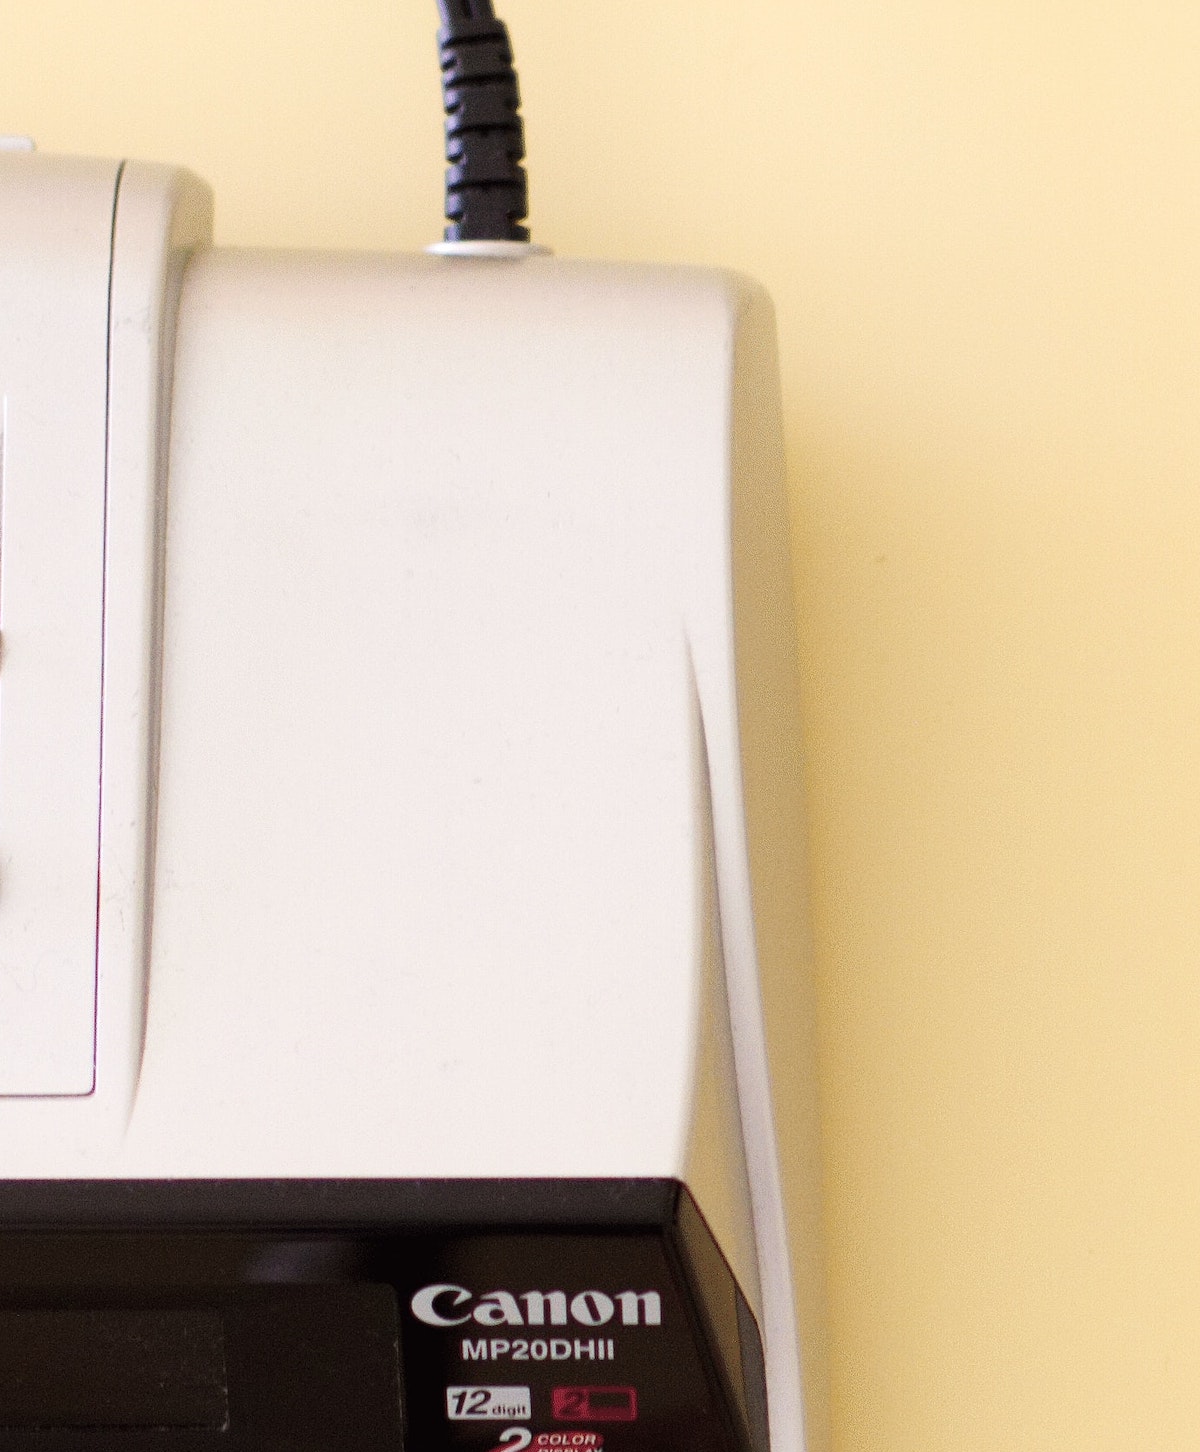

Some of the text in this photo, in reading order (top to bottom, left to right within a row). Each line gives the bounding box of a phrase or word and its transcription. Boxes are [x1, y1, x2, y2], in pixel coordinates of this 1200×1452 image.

[411, 1284, 662, 1327] Canon
[461, 1338, 615, 1361] MP20DHII
[453, 1390, 526, 1418] 12 digit
[537, 1433, 597, 1446] COLOR
